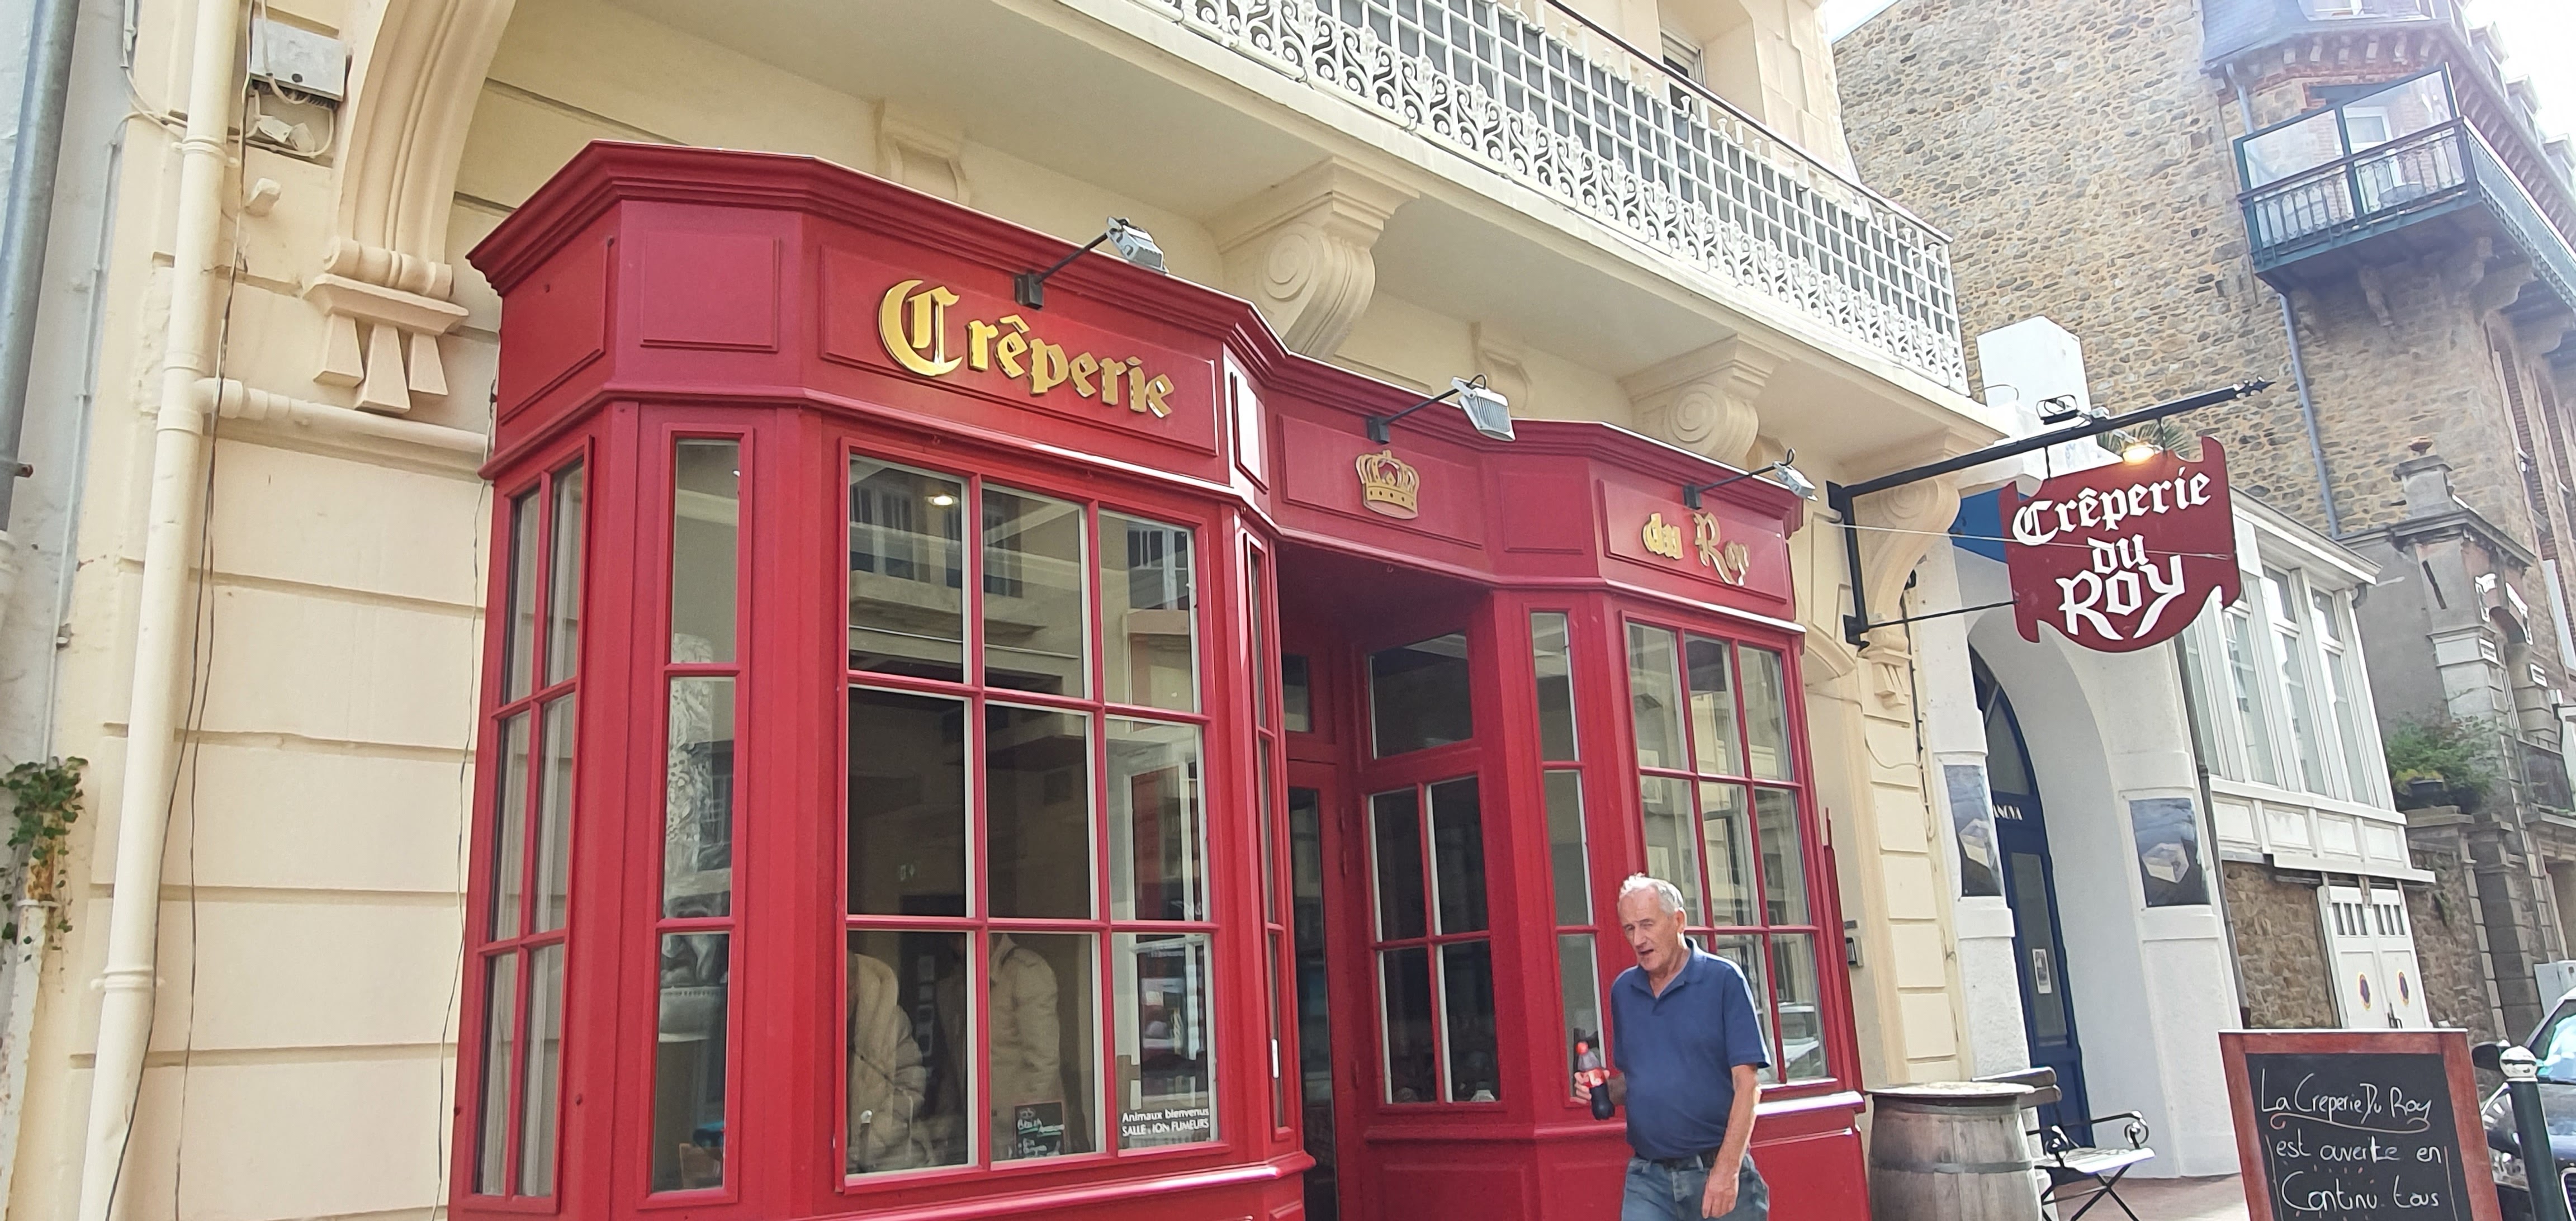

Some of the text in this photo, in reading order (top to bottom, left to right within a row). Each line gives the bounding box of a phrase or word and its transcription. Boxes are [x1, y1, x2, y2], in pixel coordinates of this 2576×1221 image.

[879, 280, 1175, 418] Crêperie
[2011, 466, 2212, 546] Crêperie
[1641, 512, 1751, 586] du Roy
[2087, 533, 2149, 575] du
[1122, 1108, 1209, 1123] Animaux bienvenus
[2261, 1068, 2291, 1113] La
[2359, 1083, 2382, 1124] Du
[2390, 1086, 2432, 1120] Roy
[1122, 1124, 1147, 1137] SALLE
[1171, 1118, 1209, 1132] FUMEURS
[2276, 1128, 2311, 1158] est
[2416, 1146, 2442, 1164] en
[2393, 1175, 2440, 1209] tous
